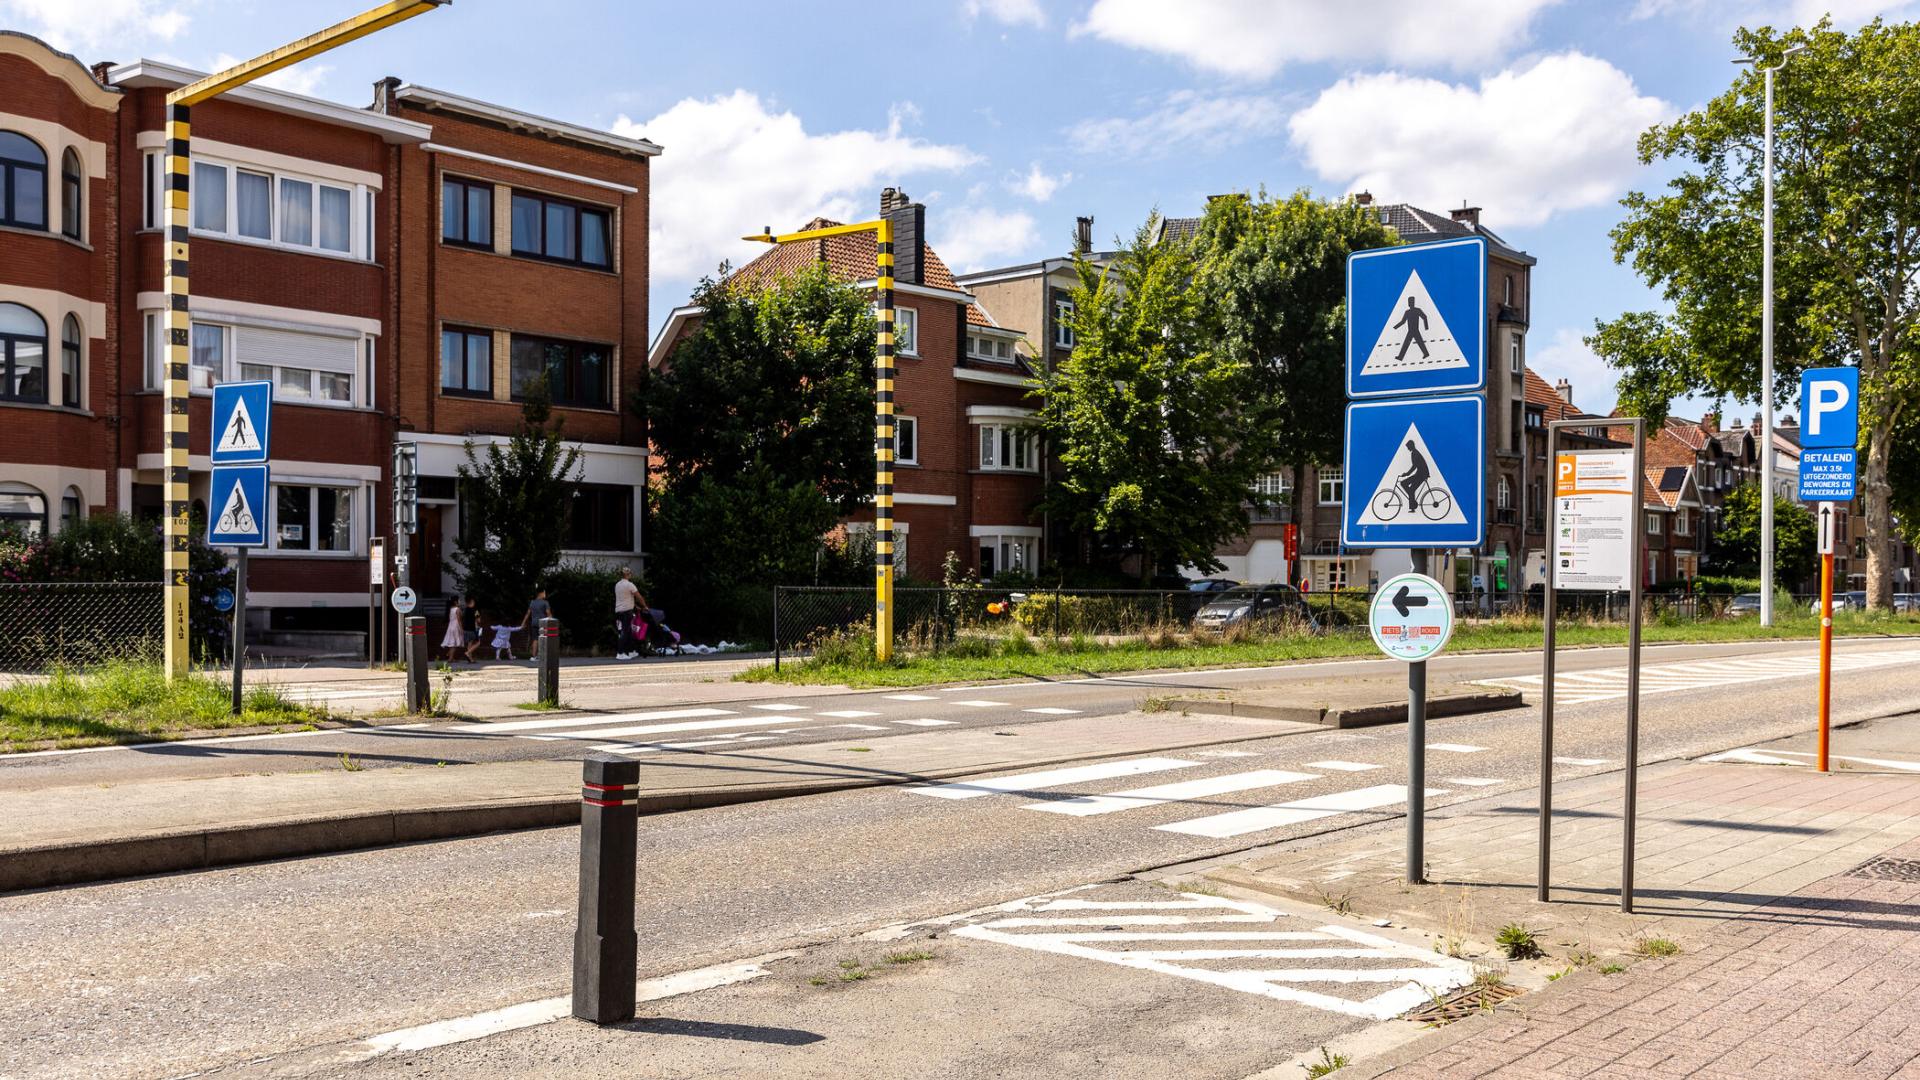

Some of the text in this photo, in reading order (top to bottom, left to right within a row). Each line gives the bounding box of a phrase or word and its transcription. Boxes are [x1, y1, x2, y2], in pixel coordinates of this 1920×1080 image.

[1808, 380, 1850, 435] P
[1803, 453, 1852, 462] BETALEND
[1558, 462, 1572, 480] P
[1800, 488, 1853, 496] PARKEERKAART
